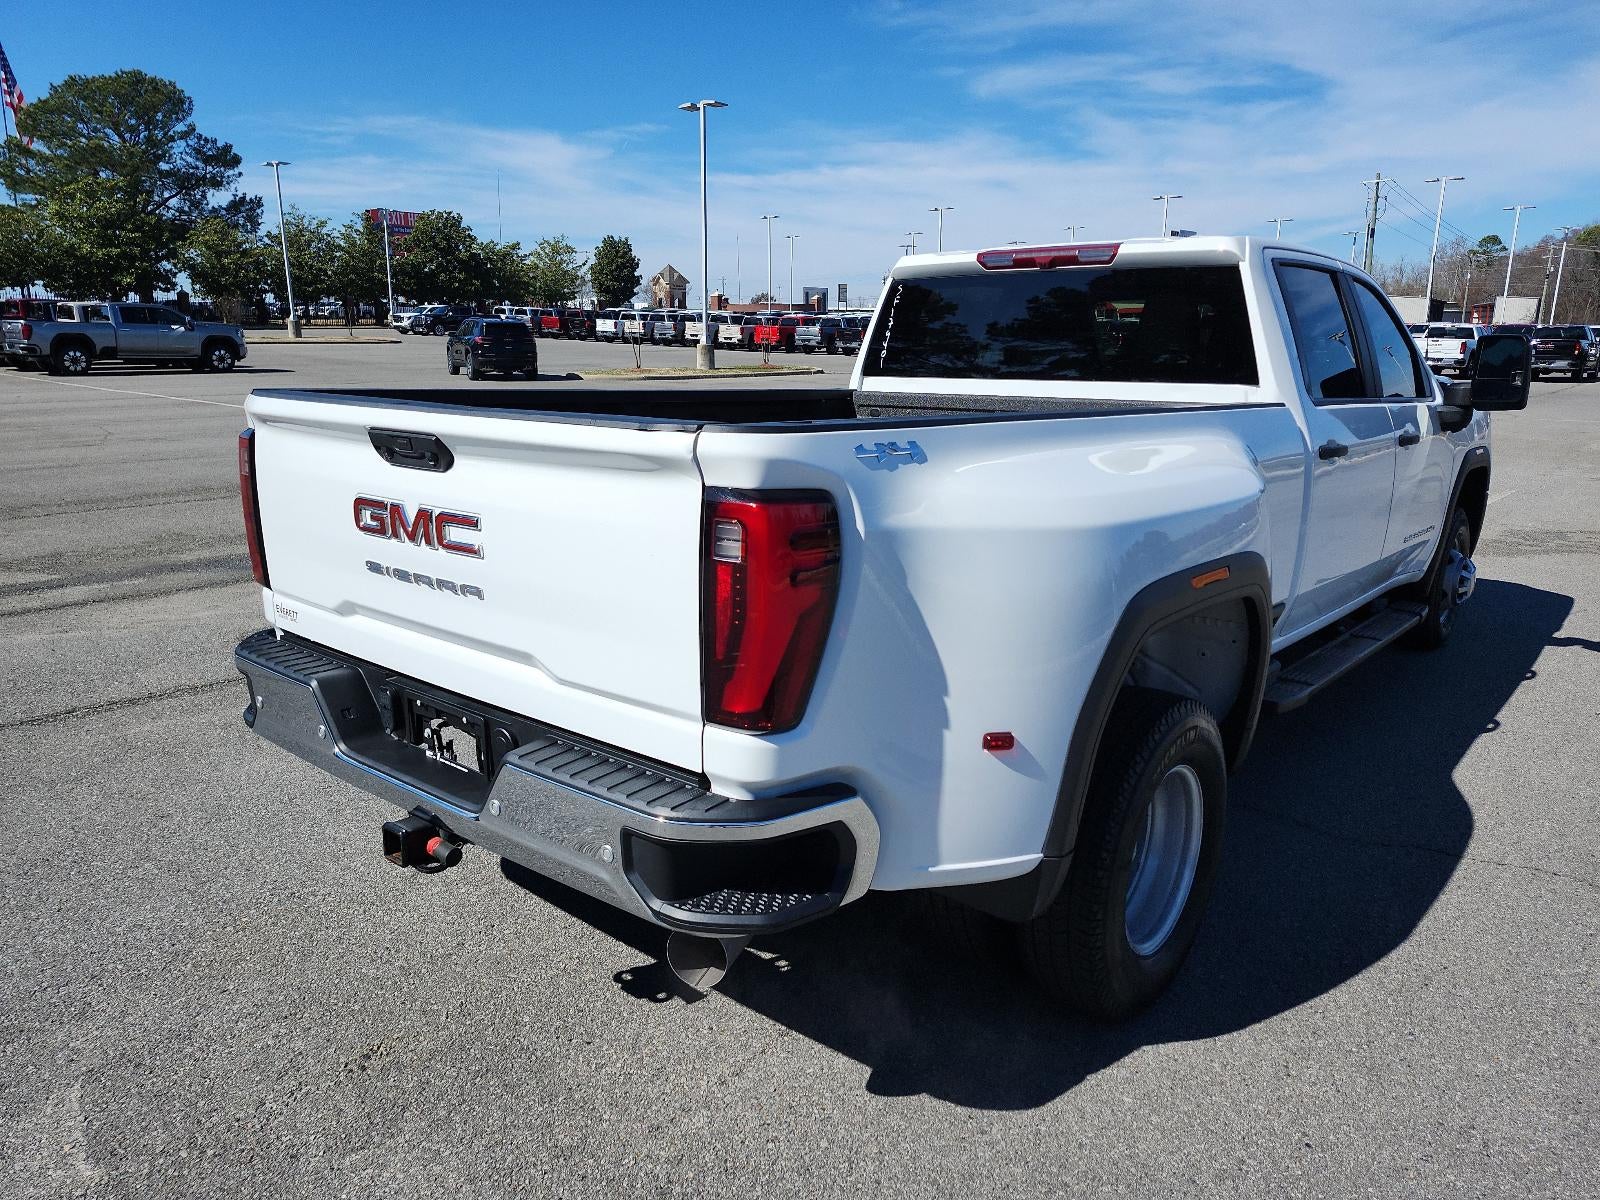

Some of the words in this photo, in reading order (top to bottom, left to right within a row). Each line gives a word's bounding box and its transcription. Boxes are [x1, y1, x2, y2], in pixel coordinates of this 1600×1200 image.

[387, 211, 404, 226] EXIT
[353, 492, 484, 560] GMC
[365, 560, 485, 600] SIERRA
